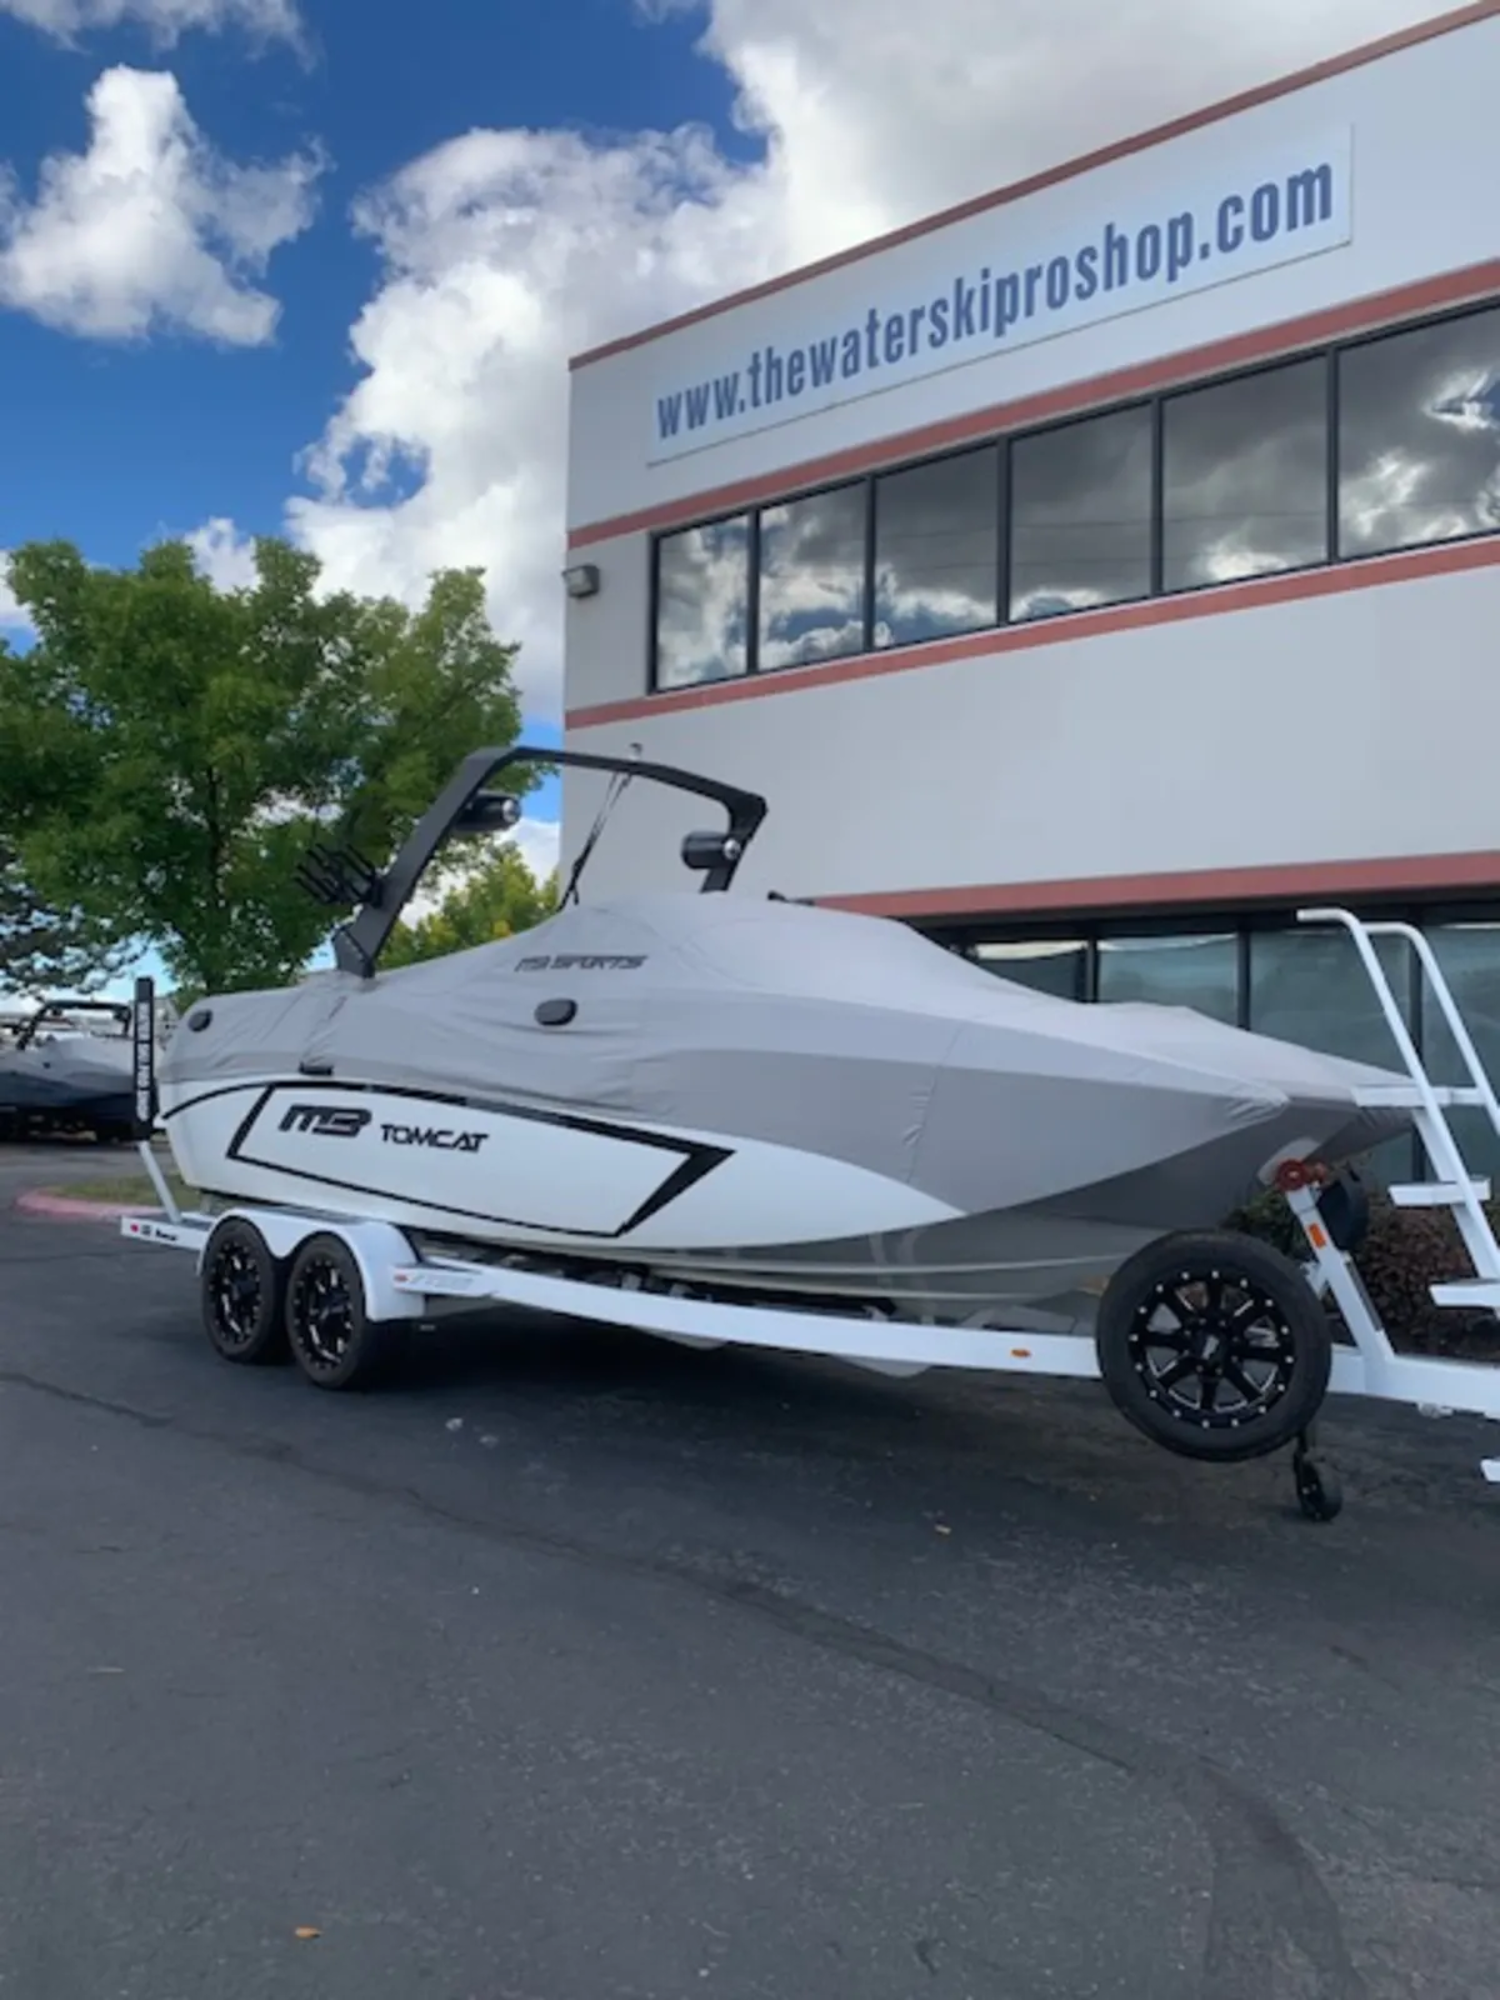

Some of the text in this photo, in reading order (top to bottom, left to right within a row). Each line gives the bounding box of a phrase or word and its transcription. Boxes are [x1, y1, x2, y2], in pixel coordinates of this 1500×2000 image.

[657, 162, 1332, 440] www.thewaterskiproshop.com
[551, 954, 647, 970] SPORTS
[380, 1124, 489, 1154] TOMCAT
